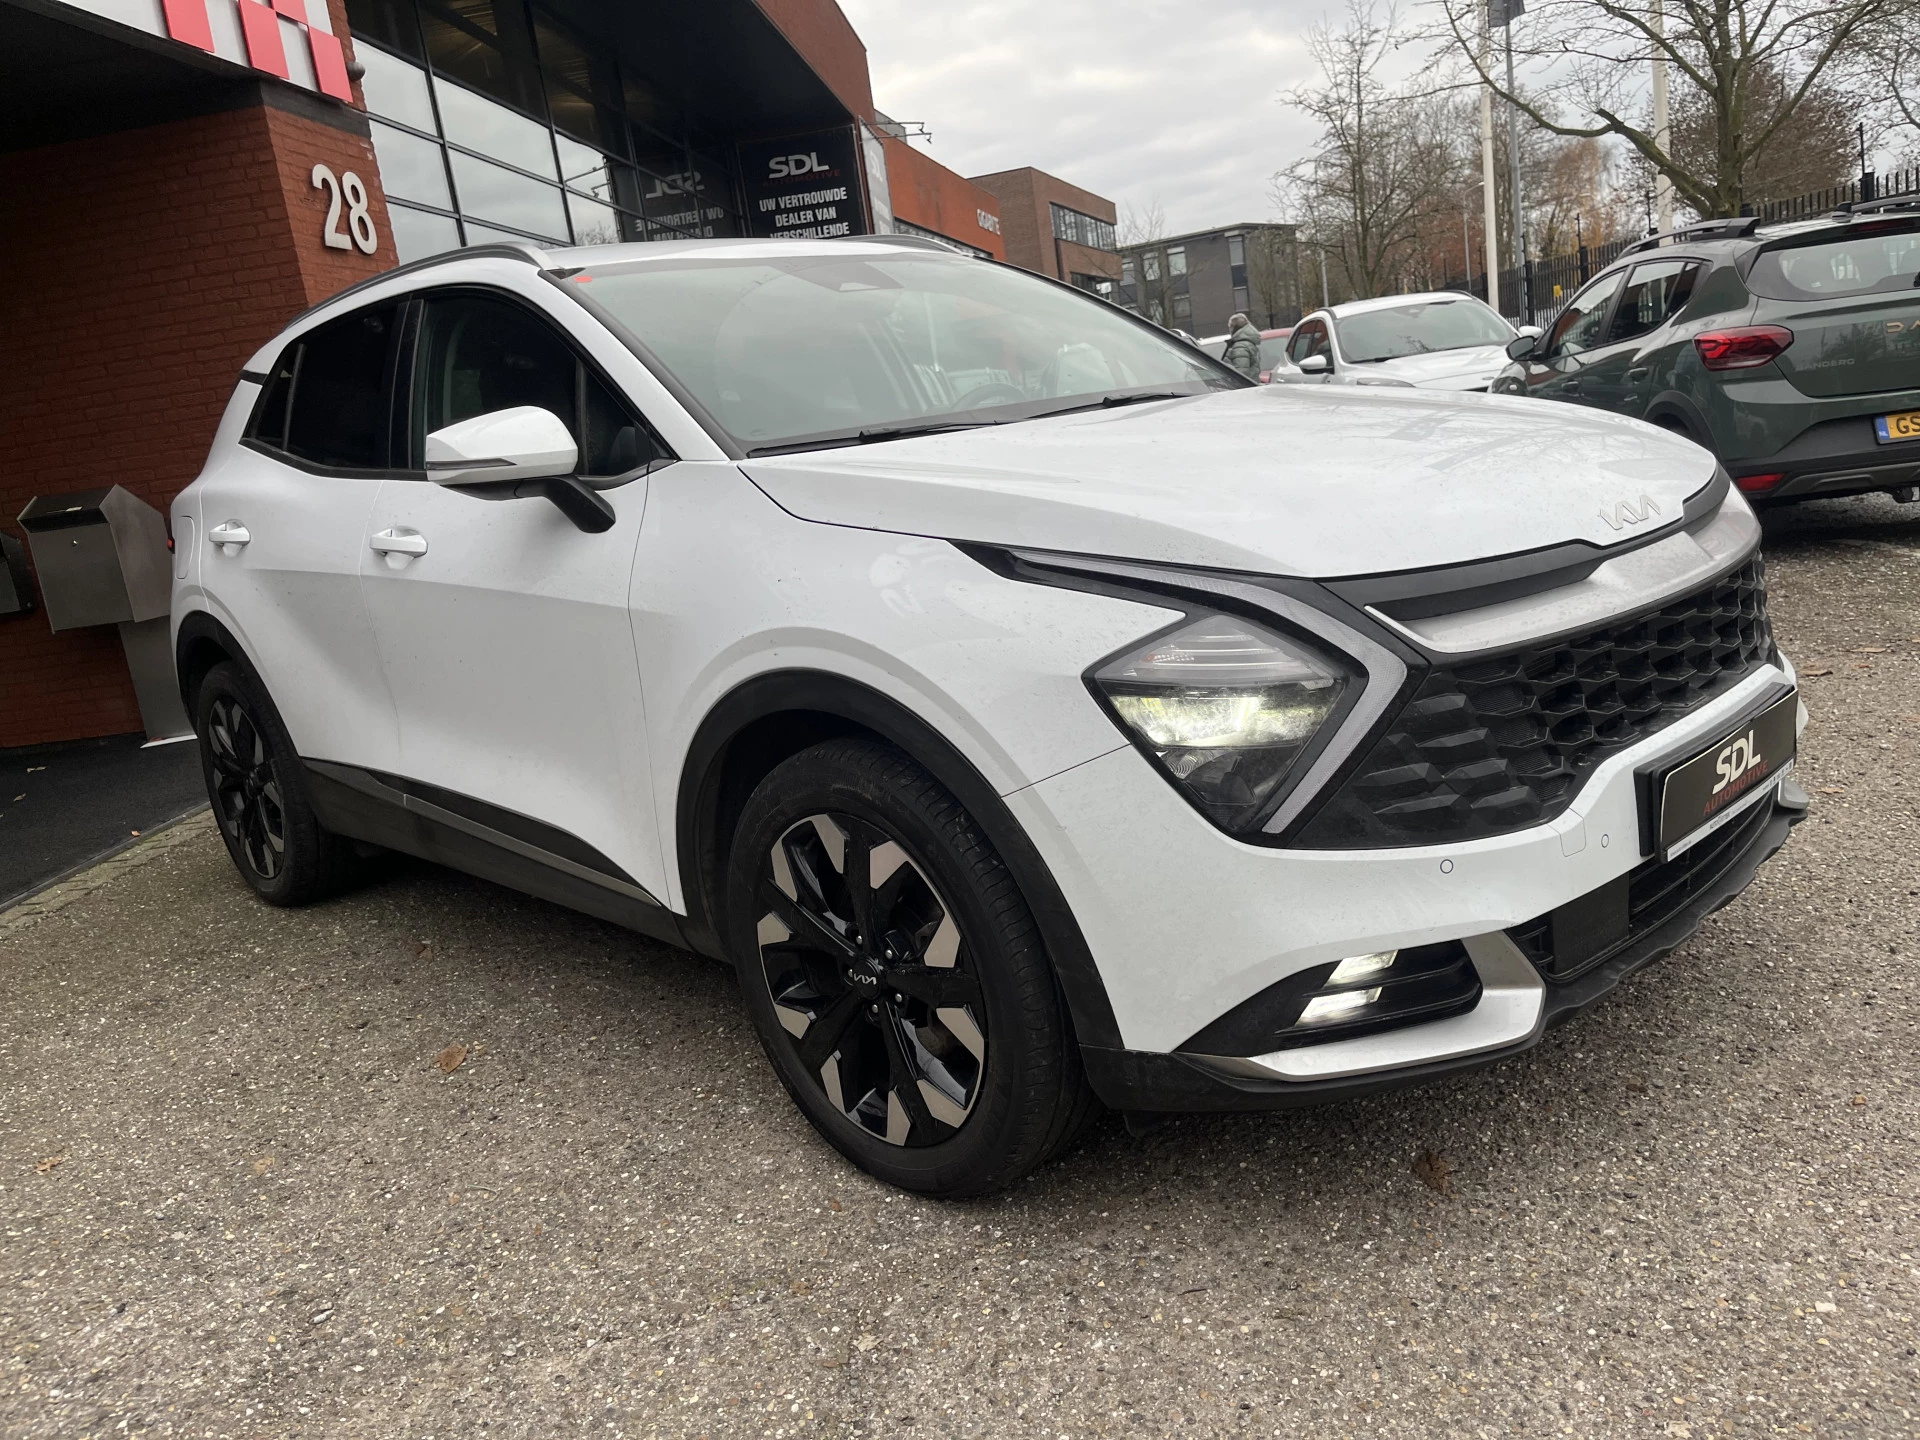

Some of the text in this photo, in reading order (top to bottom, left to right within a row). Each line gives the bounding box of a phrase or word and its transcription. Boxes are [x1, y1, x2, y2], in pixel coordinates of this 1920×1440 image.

[768, 152, 830, 179] SDL
[313, 164, 378, 254] 28
[759, 187, 848, 212] UW VERTROUWDE
[775, 206, 837, 227] DEALER VAN
[1896, 415, 1920, 434] GS
[1600, 495, 1661, 530] KIA
[1712, 730, 1761, 794] SDL
[1703, 761, 1768, 815] AUTOMOTIVE
